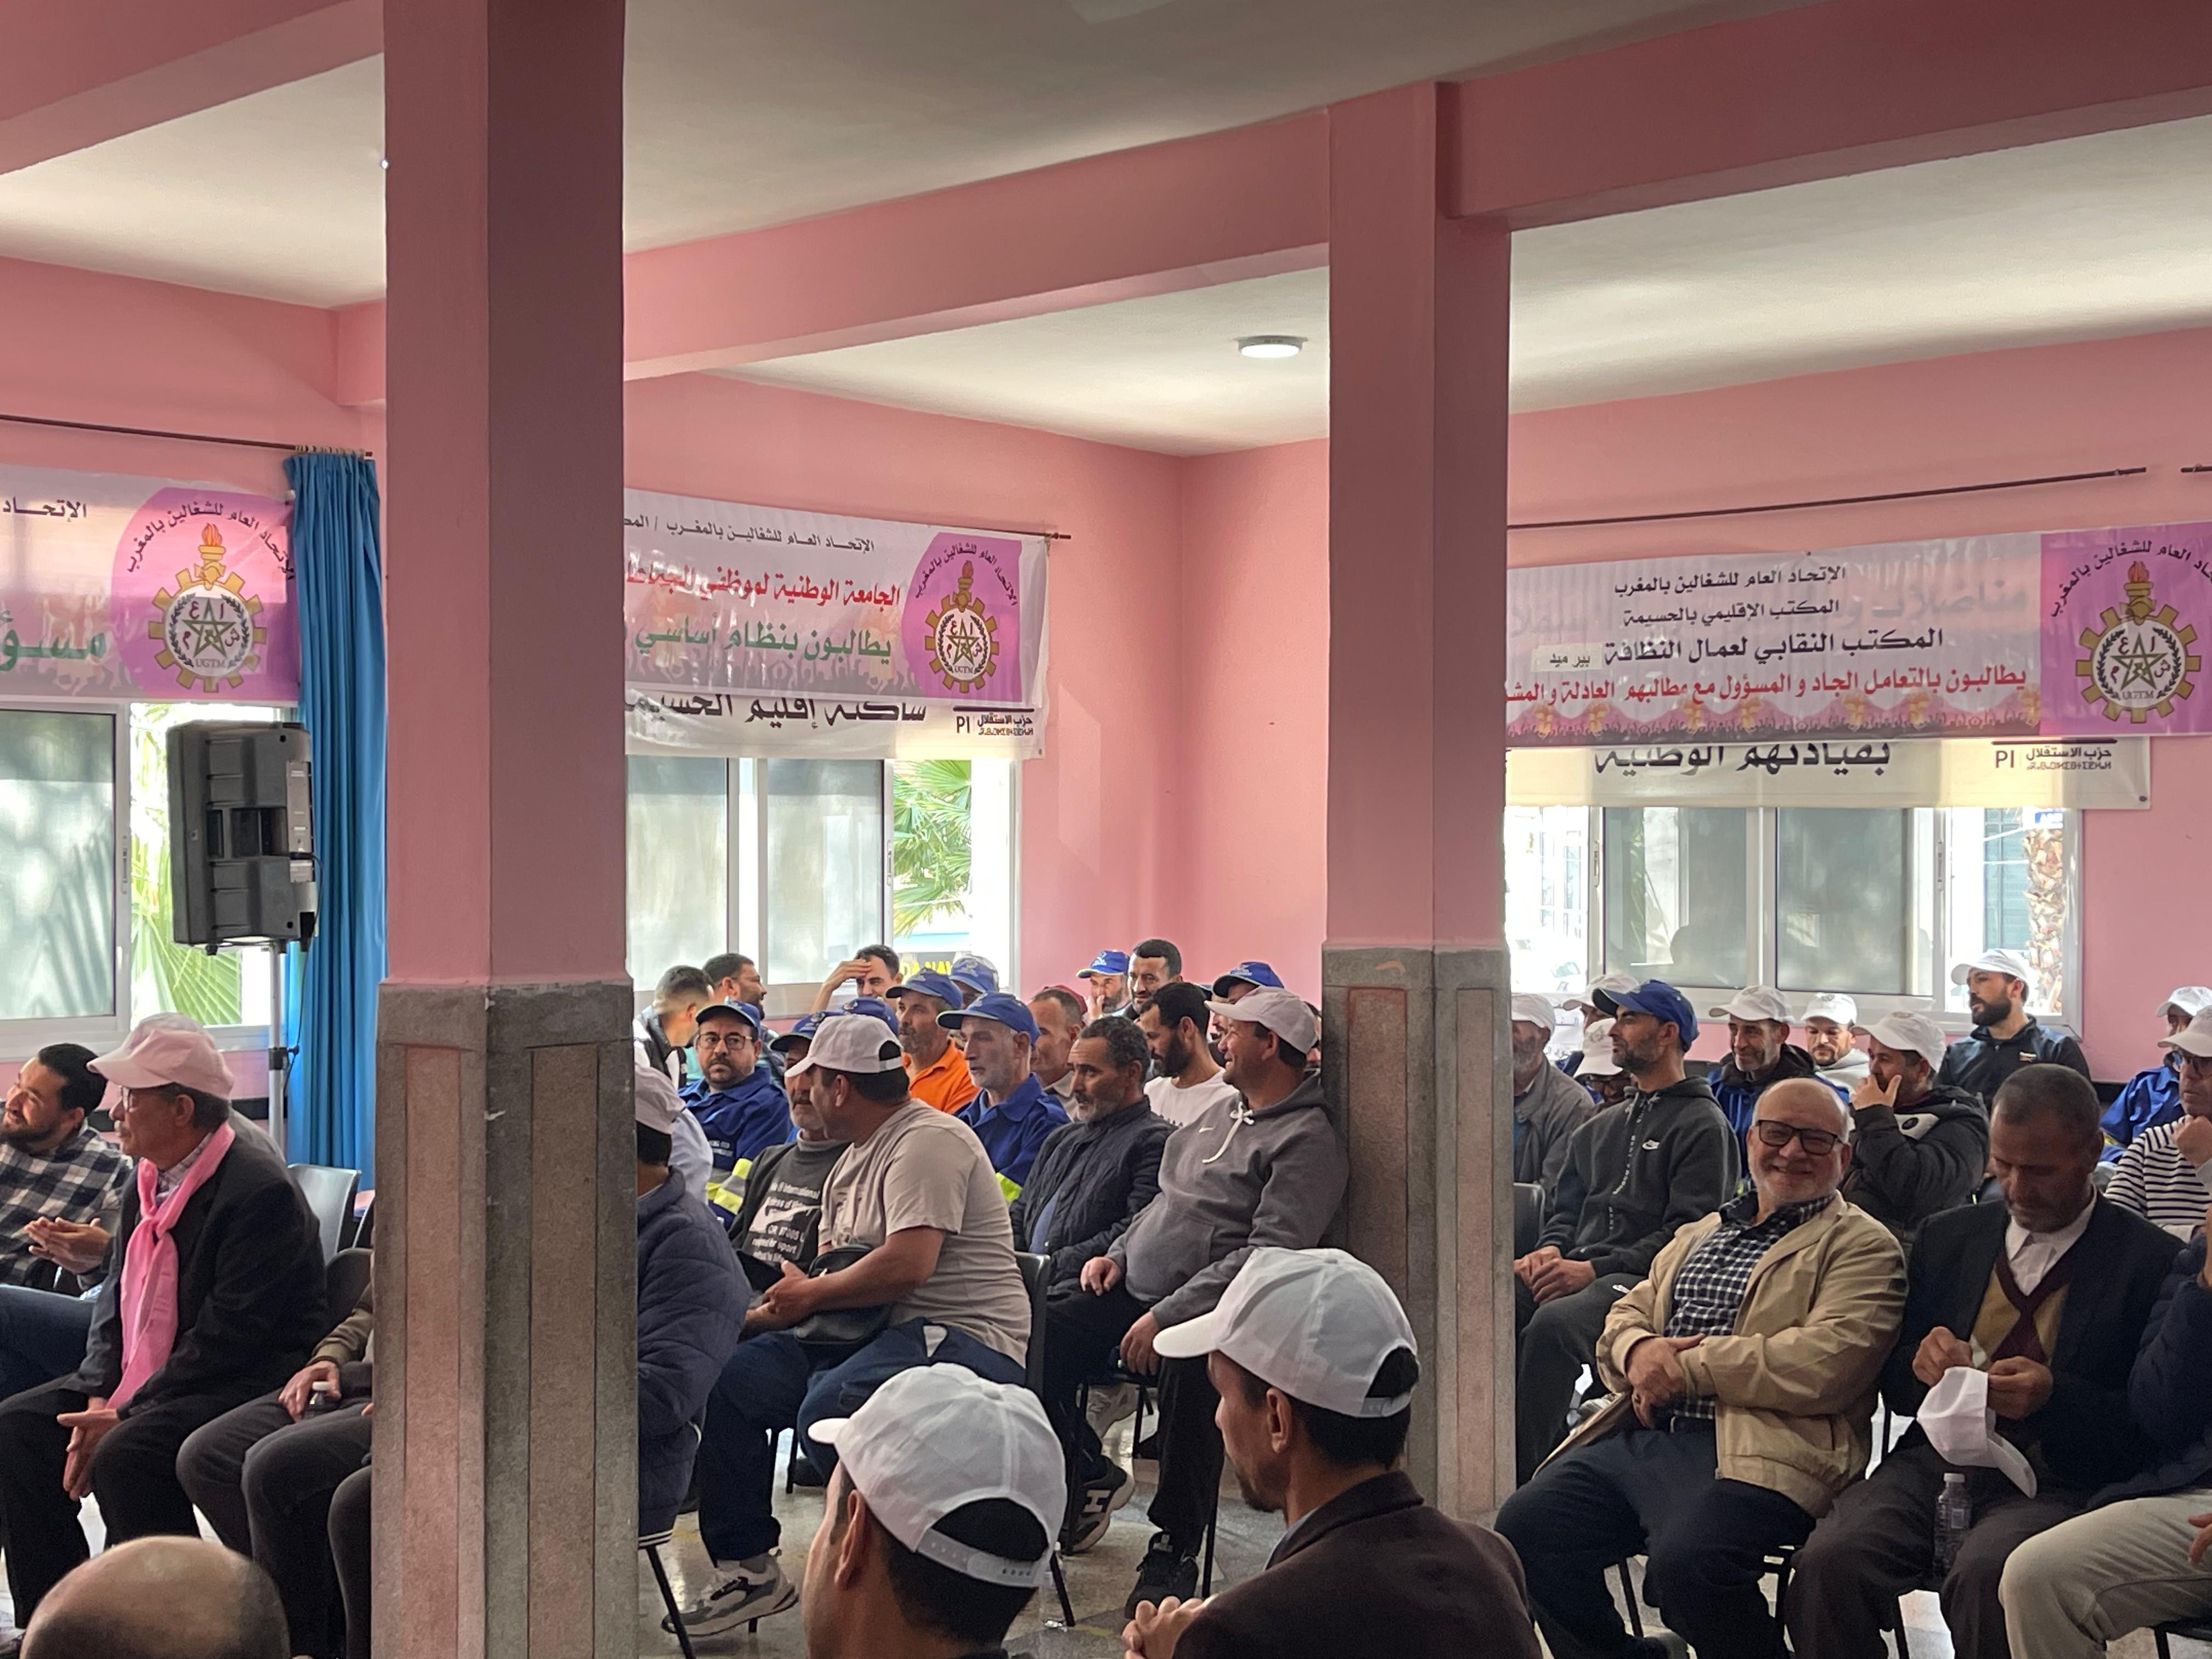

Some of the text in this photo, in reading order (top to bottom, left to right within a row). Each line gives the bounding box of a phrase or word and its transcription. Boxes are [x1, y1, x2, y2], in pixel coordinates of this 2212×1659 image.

[3, 496, 87, 522] الإتحاد
[167, 500, 223, 527] للشغالين
[226, 510, 259, 531] العام
[667, 519, 723, 540] بالمغرب
[727, 525, 782, 542] للشغالين
[787, 531, 821, 546] العام
[127, 520, 166, 572] بالمغرب
[826, 535, 874, 554] الإتحاد
[944, 543, 977, 563] للشغالين
[2094, 540, 2152, 569] للشغالين
[2157, 544, 2191, 561] العام
[979, 550, 997, 566] العام
[699, 566, 769, 601] لموظفي
[774, 573, 839, 606] الوطنية
[915, 557, 941, 599] بالمغرب
[1615, 565, 1846, 597] الإتحاد العام للشغالين بالمغرب
[844, 579, 901, 612] الجامعة
[2050, 565, 2091, 617] بالمغرب
[1623, 606, 1697, 627] بالحسيمة
[1701, 602, 1764, 627] الإقليمي
[1770, 598, 1839, 620] المكتب
[635, 612, 891, 665] يطالبون بنظام أساسي
[1689, 635, 1748, 663] لعمال
[1754, 633, 1833, 664] النقابي
[1842, 627, 1943, 656] المكتب
[196, 658, 225, 668] UGTM
[1605, 640, 1681, 665] النظافة
[1624, 676, 1688, 703] مطالبهم
[1719, 672, 1791, 699] المسؤول
[1795, 679, 1805, 697] و
[1813, 669, 1858, 697] الجاد
[1864, 667, 1940, 694] بالتعامل
[1945, 664, 2026, 693] يطالبون
[1548, 687, 1557, 706] و
[1561, 680, 1615, 703] العادلة
[1692, 682, 1715, 705] مع
[2122, 690, 2154, 699] UGTM
[956, 715, 970, 733] PI
[1013, 714, 1032, 727] حزب
[1996, 750, 2015, 768] PI
[2026, 745, 2112, 761] حزب الاستقلال
